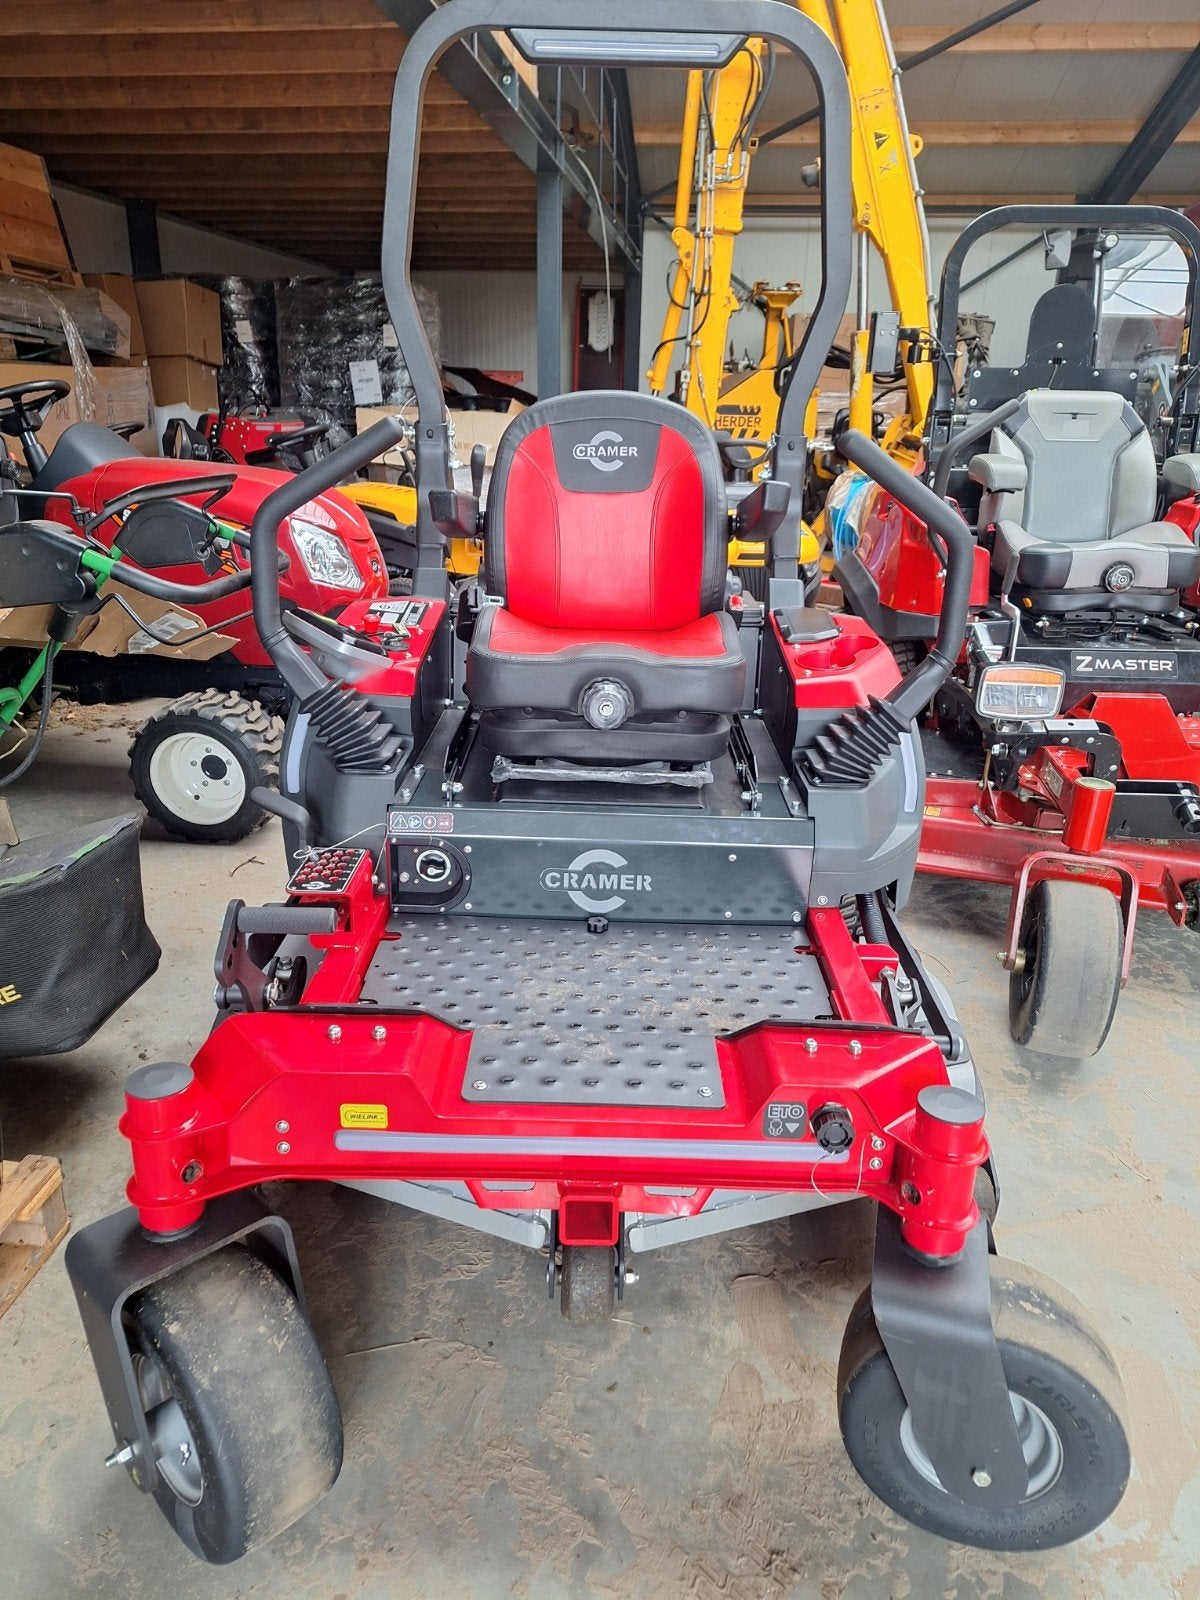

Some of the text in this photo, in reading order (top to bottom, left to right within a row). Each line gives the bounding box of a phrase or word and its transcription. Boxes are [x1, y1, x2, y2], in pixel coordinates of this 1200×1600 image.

[715, 416, 761, 427] HERDER
[576, 446, 638, 457] CRAMER
[1075, 655, 1173, 671] Z MASTER
[545, 872, 652, 891] CRAMER
[768, 1104, 804, 1119] ETO
